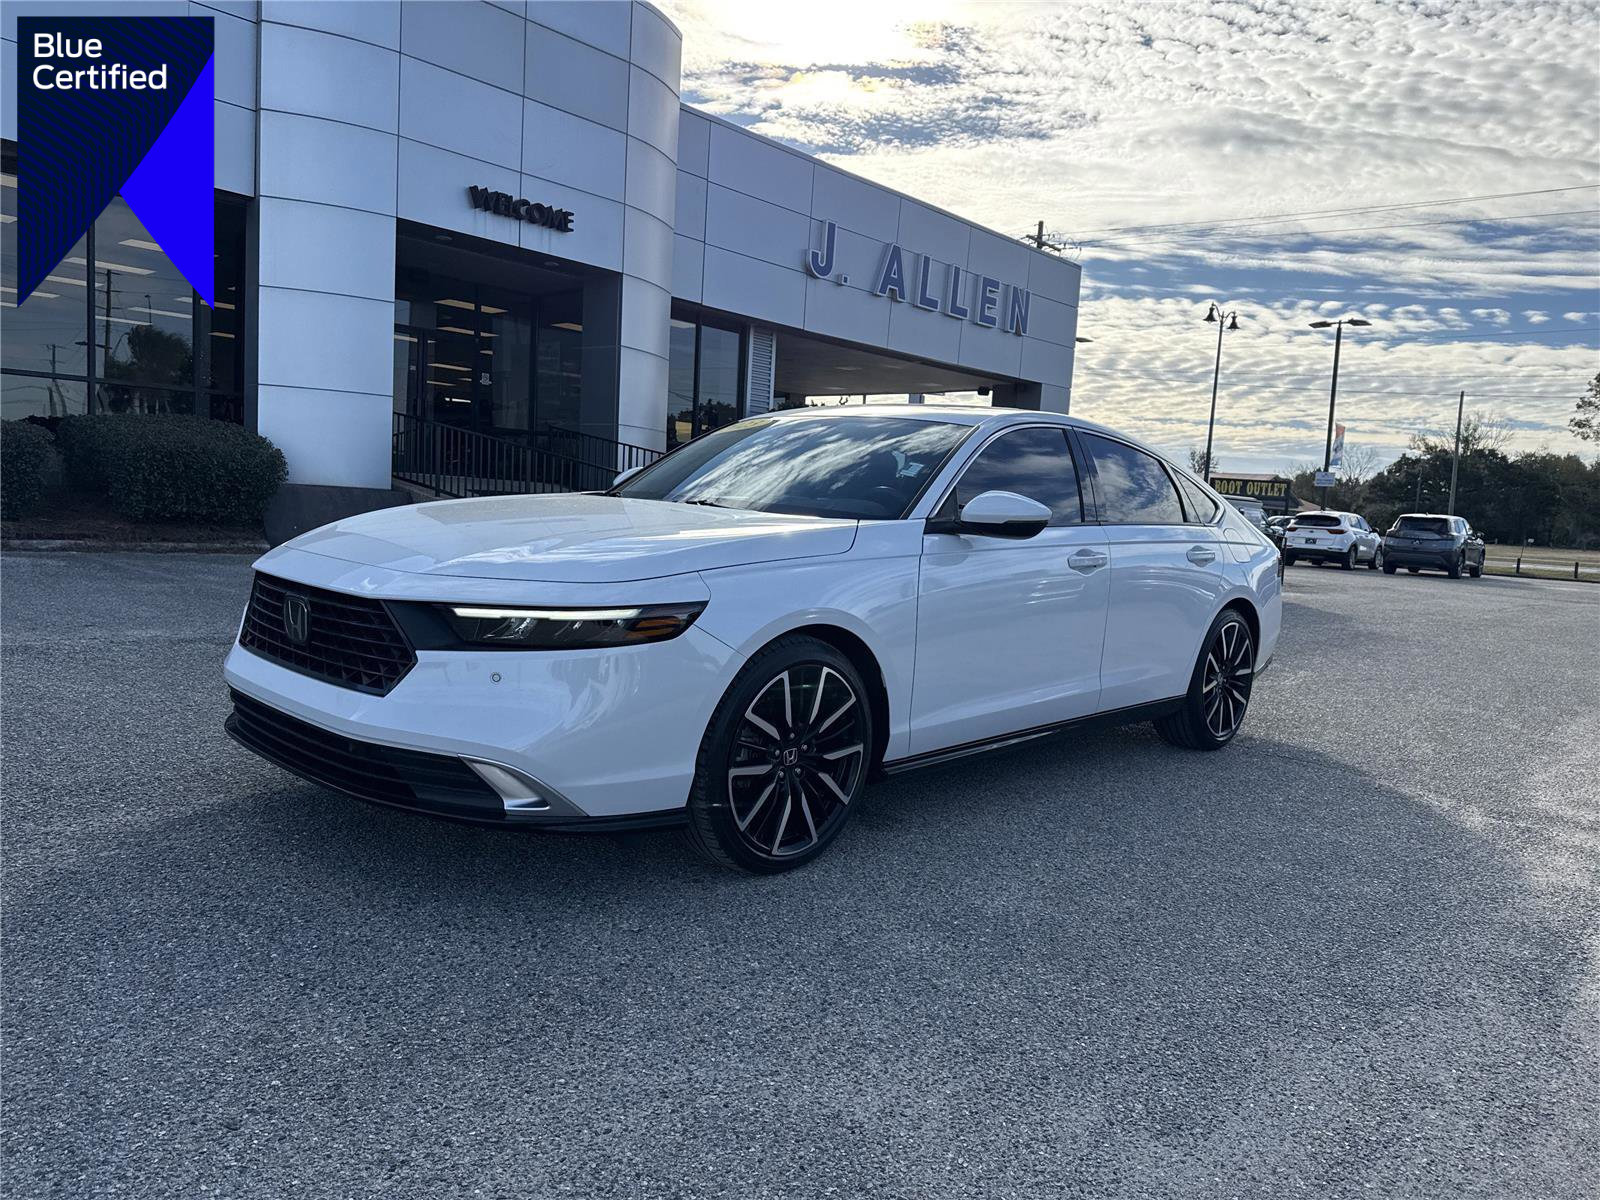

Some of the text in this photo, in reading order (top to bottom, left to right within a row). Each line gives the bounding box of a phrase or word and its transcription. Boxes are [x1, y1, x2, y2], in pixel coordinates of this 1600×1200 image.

[468, 185, 575, 233] WELCOME
[806, 219, 1032, 336] J. ALLEN
[1214, 480, 1288, 497] BOOT OUTLET
